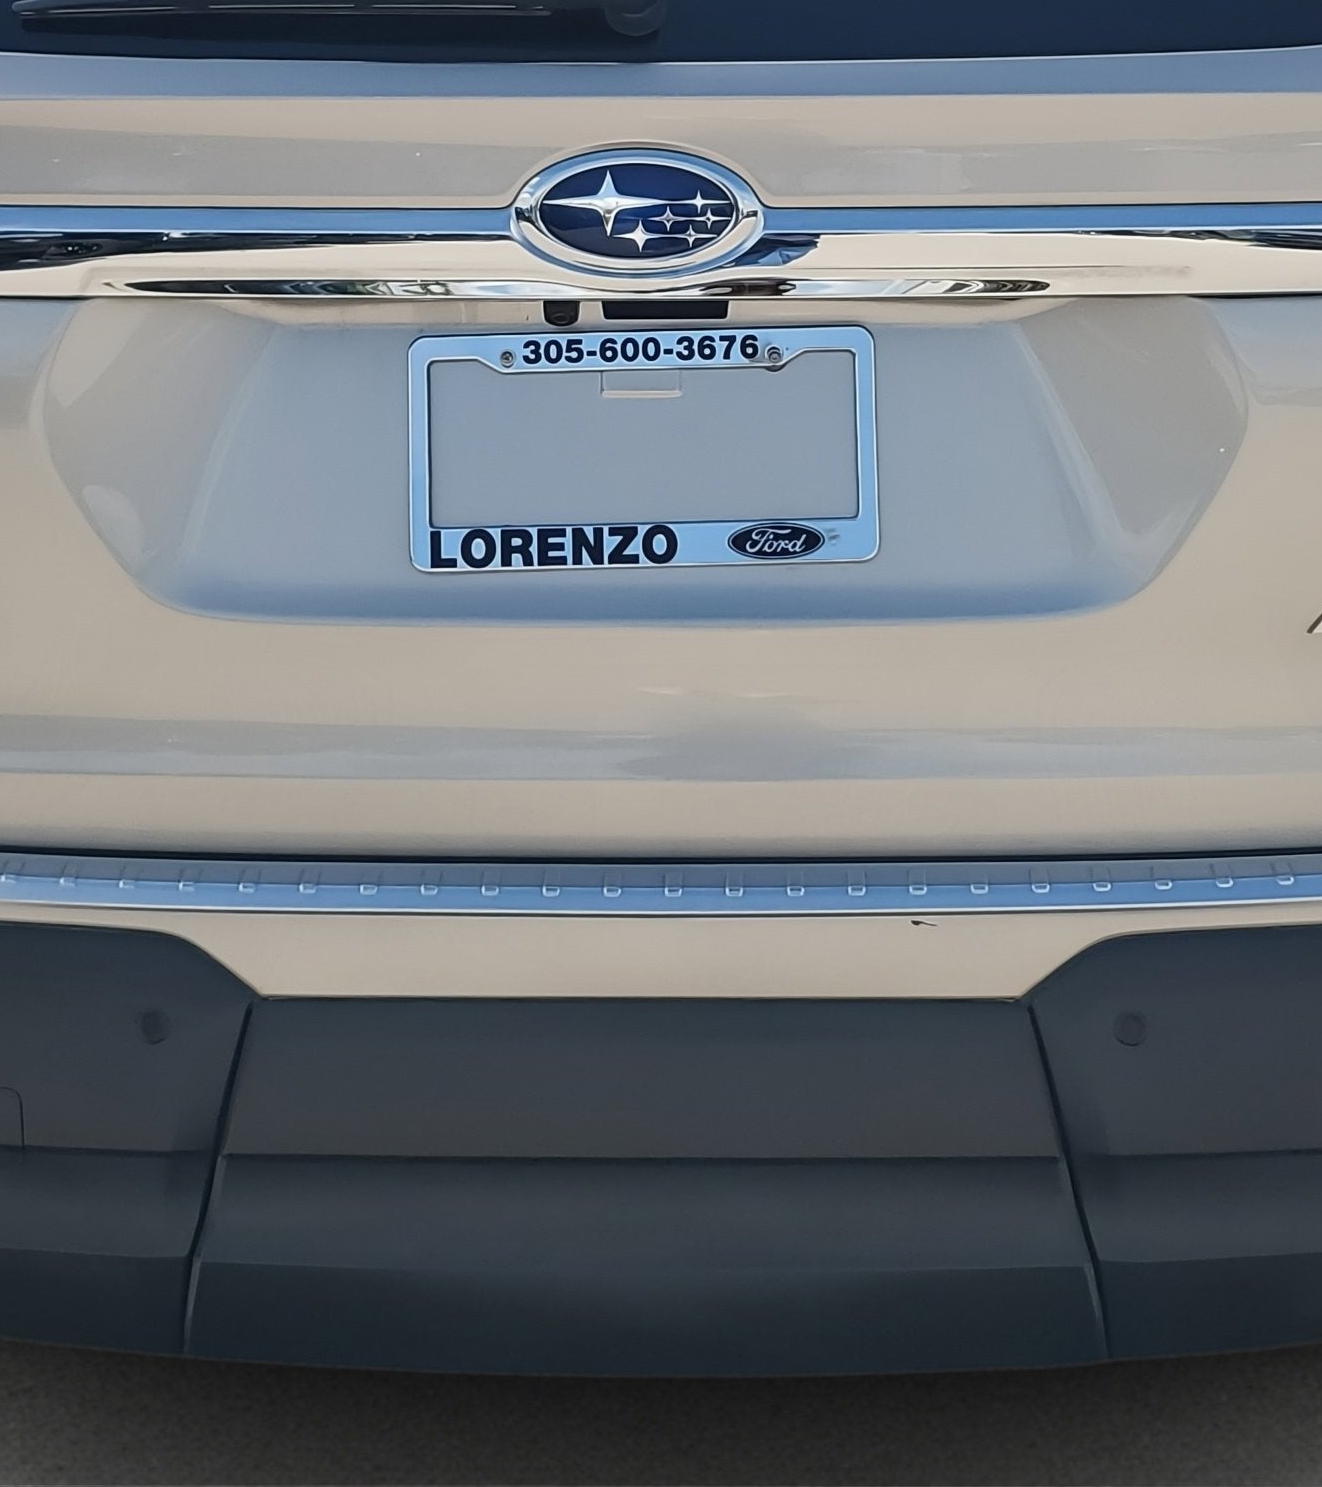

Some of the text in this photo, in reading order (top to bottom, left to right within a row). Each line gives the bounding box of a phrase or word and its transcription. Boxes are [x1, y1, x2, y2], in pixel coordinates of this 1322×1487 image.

[521, 333, 760, 366] 305-600-3676
[429, 523, 808, 570] LORENZO Ford
